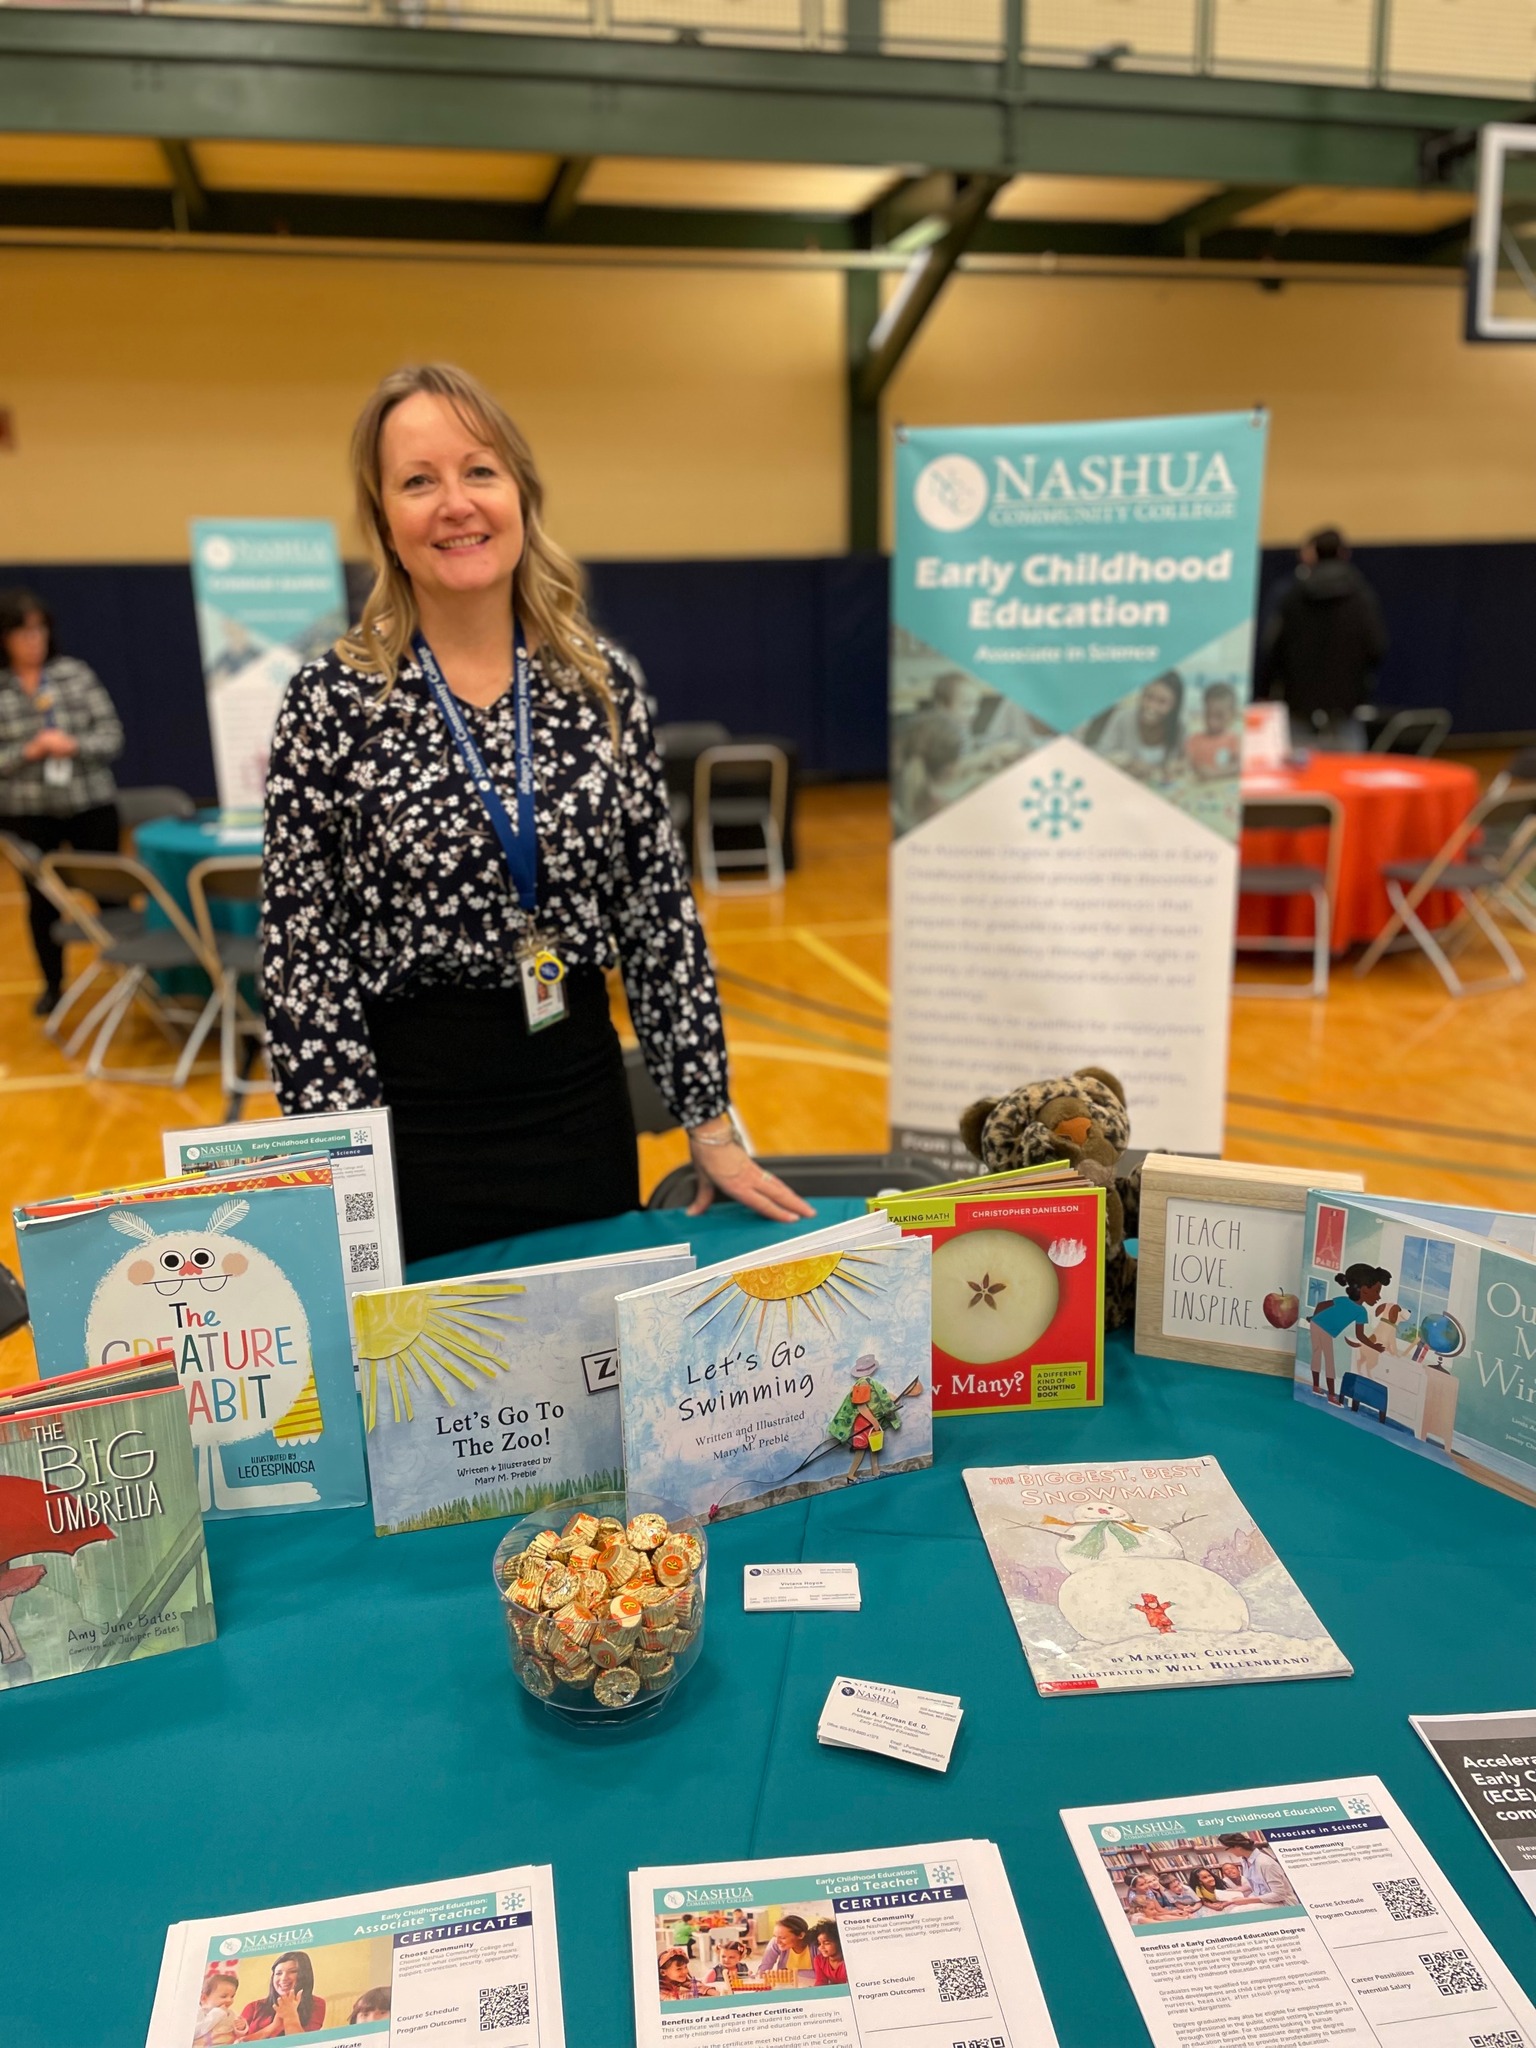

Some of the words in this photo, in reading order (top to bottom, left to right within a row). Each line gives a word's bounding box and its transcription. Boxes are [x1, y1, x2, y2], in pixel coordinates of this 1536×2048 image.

[994, 451, 1237, 498] NASHUA
[989, 504, 1128, 526] COMMUNITY
[1134, 500, 1236, 522] COLLEGE
[915, 556, 1014, 594] Early
[1021, 550, 1233, 587] Childhood
[969, 595, 1170, 630] Education
[418, 646, 440, 683] College
[974, 644, 1061, 664] Associate
[1066, 644, 1083, 662] in
[1088, 644, 1159, 662] Science
[517, 660, 528, 696] Nashua
[435, 683, 467, 741] Community
[517, 697, 530, 756] Community
[463, 741, 485, 778] Nashua
[518, 757, 533, 795] College
[201, 1143, 243, 1155] NASHUA
[252, 1142, 270, 1151] Early
[271, 1138, 309, 1148] Childhood
[311, 1134, 346, 1144] Education
[972, 1207, 1030, 1218] CHRISTOPHER
[1032, 1205, 1079, 1214] DANIELSON
[1176, 1215, 1245, 1251] TEACH.
[1172, 1254, 1233, 1289] LOVE.
[1315, 1257, 1340, 1271] PARIS
[169, 1302, 221, 1329] The
[1171, 1290, 1258, 1330] INSPIRE.
[687, 1351, 758, 1385] Let's
[771, 1341, 806, 1368] Go
[951, 1371, 1025, 1397] Many?
[189, 1374, 272, 1425] ABIT
[679, 1374, 815, 1421] Swimming
[436, 1410, 490, 1436] Let's
[498, 1406, 529, 1424] Go
[536, 1401, 565, 1421] To
[695, 1428, 733, 1447] Written
[735, 1423, 753, 1437] and
[756, 1411, 805, 1432] Illustrated
[30, 1422, 63, 1443] THE
[452, 1435, 494, 1458] The
[502, 1427, 550, 1451] Zoo!
[745, 1434, 757, 1444] by
[713, 1446, 738, 1461] Mary
[741, 1441, 756, 1453] M.
[759, 1433, 789, 1449] Preble
[38, 1430, 156, 1494] BIG
[251, 1452, 286, 1464] ILLUSTRATED
[288, 1452, 297, 1460] BY
[457, 1465, 489, 1477] Written
[498, 1457, 537, 1472] Illustrated
[539, 1456, 552, 1467] by
[238, 1465, 259, 1479] LEO
[261, 1460, 316, 1477] ESPINOSA
[475, 1475, 495, 1487] Mary
[497, 1472, 509, 1482] M.
[511, 1468, 536, 1480] Preble
[989, 1475, 1015, 1485] THE
[1018, 1467, 1136, 1486] BIGGEST,
[1141, 1465, 1202, 1479] BEST
[1021, 1483, 1189, 1506] SNOWMAN
[46, 1480, 163, 1534] UMBRELLA
[68, 1629, 96, 1643] Amy
[101, 1621, 133, 1635] June
[138, 1611, 177, 1627] Bates
[120, 1632, 151, 1644] Juniper
[155, 1625, 180, 1636] Bates
[1111, 1655, 1123, 1664] BY
[1129, 1650, 1197, 1663] MARGERY
[1204, 1646, 1258, 1658] CUYLER
[1071, 1669, 1143, 1680] ILLUSTRATED
[1147, 1666, 1161, 1675] BY
[1165, 1662, 1203, 1673] WILL
[1210, 1655, 1310, 1670] HILLENBRAND
[857, 1689, 899, 1705] NASHUA
[881, 1714, 906, 1724] Furman
[1471, 1770, 1520, 1787] Early
[1483, 1787, 1536, 1805] (ECE)
[1198, 1817, 1224, 1827] Early
[1227, 1811, 1281, 1823] Childhood
[1283, 1804, 1337, 1817] Education
[1120, 1820, 1184, 1835] NASHUA
[1270, 1829, 1316, 1839] Associate
[1332, 1821, 1368, 1832] Science
[816, 1877, 835, 1886] Early
[837, 1872, 876, 1883] Childhood
[878, 1868, 918, 1879] Education:
[826, 1882, 859, 1895] Lead
[863, 1876, 919, 1891] Teacher
[686, 1887, 753, 1901] NASHUA
[839, 1889, 953, 1910] CERTIFICATE
[1309, 1901, 1332, 1909] Course
[1334, 1897, 1364, 1907] Schedule
[381, 1908, 401, 1921] Early
[403, 1904, 445, 1917] Childhood
[446, 1898, 488, 1910] Education:
[843, 1917, 871, 1925] Choose
[873, 1912, 914, 1923] Community
[1315, 1911, 1344, 1921] Program
[1345, 1907, 1377, 1916] Outcomes
[354, 1913, 424, 1936] Associate
[430, 1905, 488, 1923] Teacher
[400, 1916, 518, 1944] CERTIFICATE
[243, 1928, 314, 1947] NASHUA
[1140, 1944, 1170, 1952] Benefits
[1206, 1935, 1242, 1945] Childhood
[1244, 1931, 1279, 1940] Education
[399, 1948, 428, 1960] Choose
[430, 1941, 474, 1954] Community
[855, 1979, 881, 1988] Course
[882, 1975, 916, 1985] Schedule
[1351, 1975, 1373, 1984] Career
[1375, 1969, 1414, 1981] Possibilities
[858, 1990, 888, 2001] Program
[890, 1986, 926, 1996] Outcomes
[1358, 1986, 1385, 1996] Potential
[1386, 1982, 1411, 1992] Salary
[396, 2011, 423, 2023] Course
[424, 2005, 460, 2017] Schedule
[662, 2018, 693, 2026] Benefits
[732, 2011, 762, 2019] Teacher
[764, 2007, 803, 2015] Certificate
[396, 2024, 428, 2035] Program
[429, 2016, 467, 2028] Outcomes
